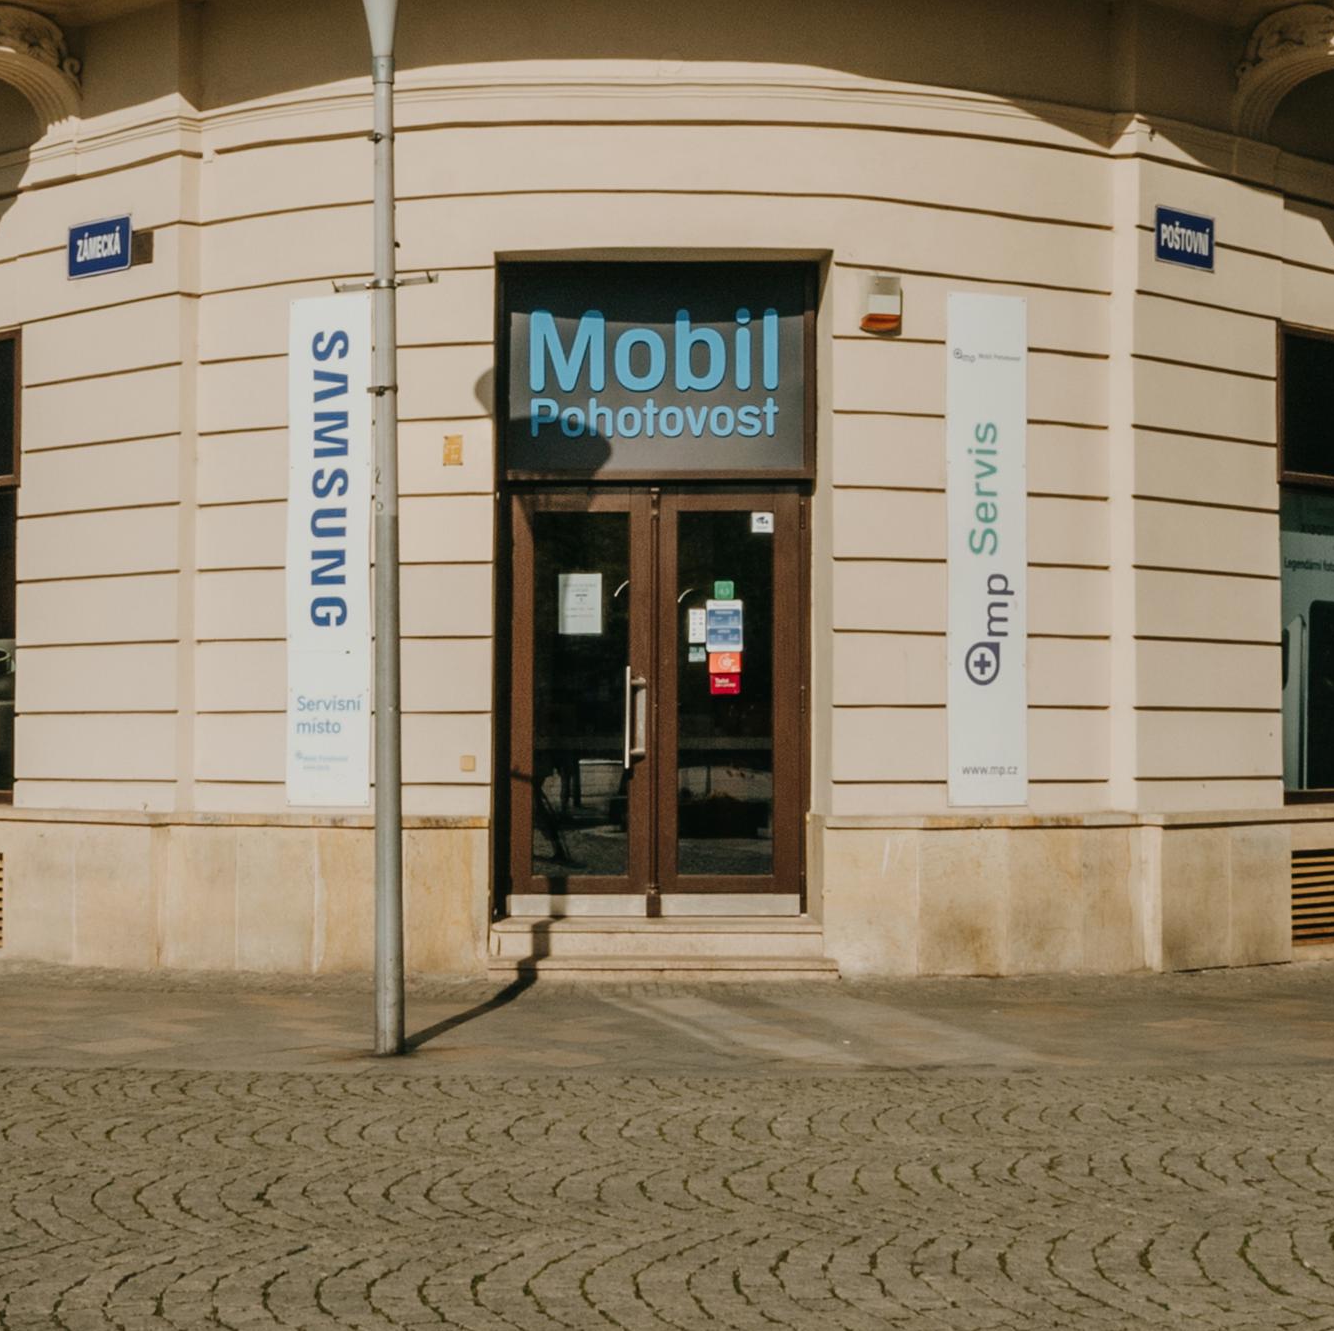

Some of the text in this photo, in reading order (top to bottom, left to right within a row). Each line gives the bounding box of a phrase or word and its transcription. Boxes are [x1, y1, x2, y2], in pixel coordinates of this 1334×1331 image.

[76, 226, 121, 263] ZÁMECKÁ
[1161, 221, 1210, 257] POŠTOVNÍ
[529, 308, 780, 393] Mobil
[529, 396, 780, 438] Pohotovost
[310, 330, 350, 628] SAMSUNG
[968, 422, 999, 556] Servis
[297, 694, 364, 711] Servisní
[296, 717, 341, 734] místo
[962, 765, 1018, 777] www.mp.cz
